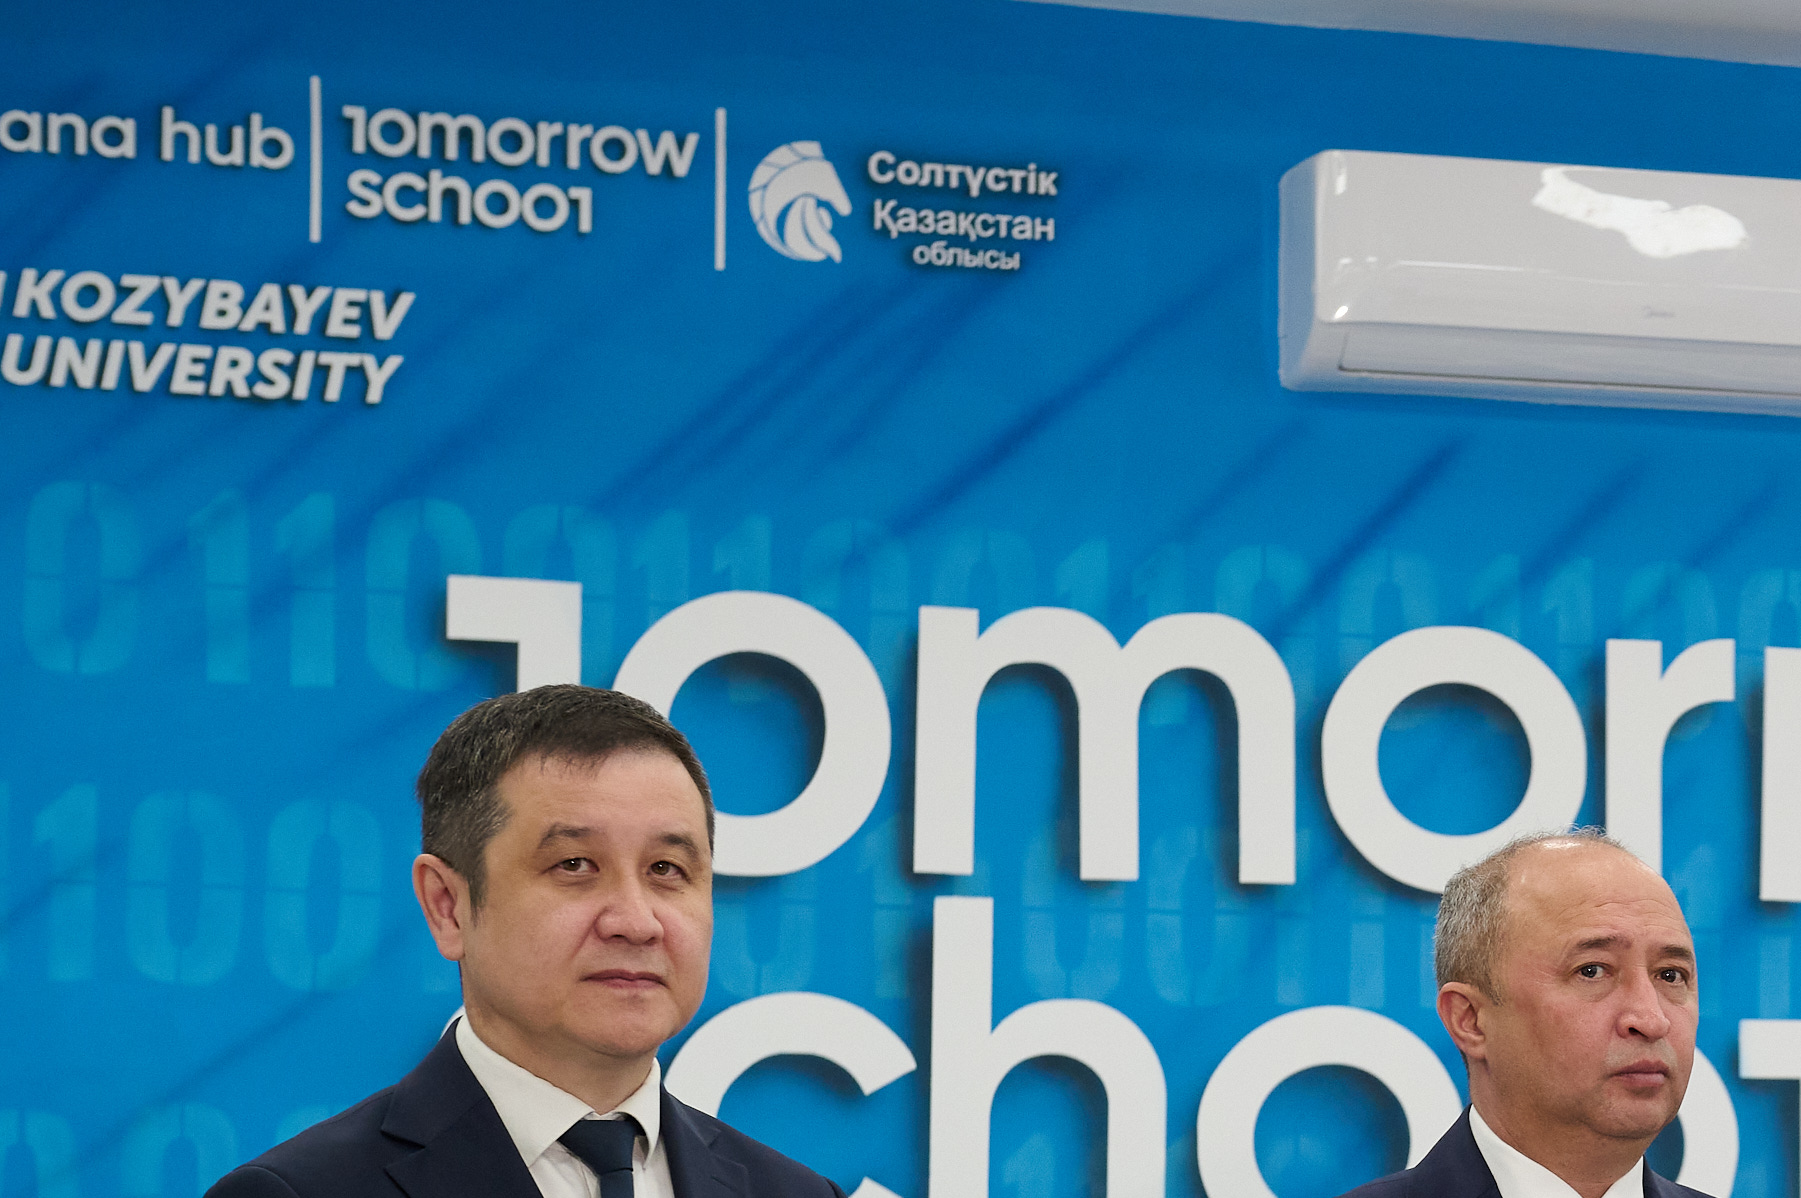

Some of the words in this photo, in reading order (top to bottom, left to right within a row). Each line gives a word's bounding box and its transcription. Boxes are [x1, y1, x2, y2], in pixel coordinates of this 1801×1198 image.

[161, 105, 296, 170] hub
[866, 150, 1059, 198] Солтүстік
[872, 198, 1056, 242] Қазақстан
[912, 239, 1021, 271] облысы
[12, 267, 416, 342] KOZYBAYEV
[2, 333, 404, 405] UNIVERSITY
